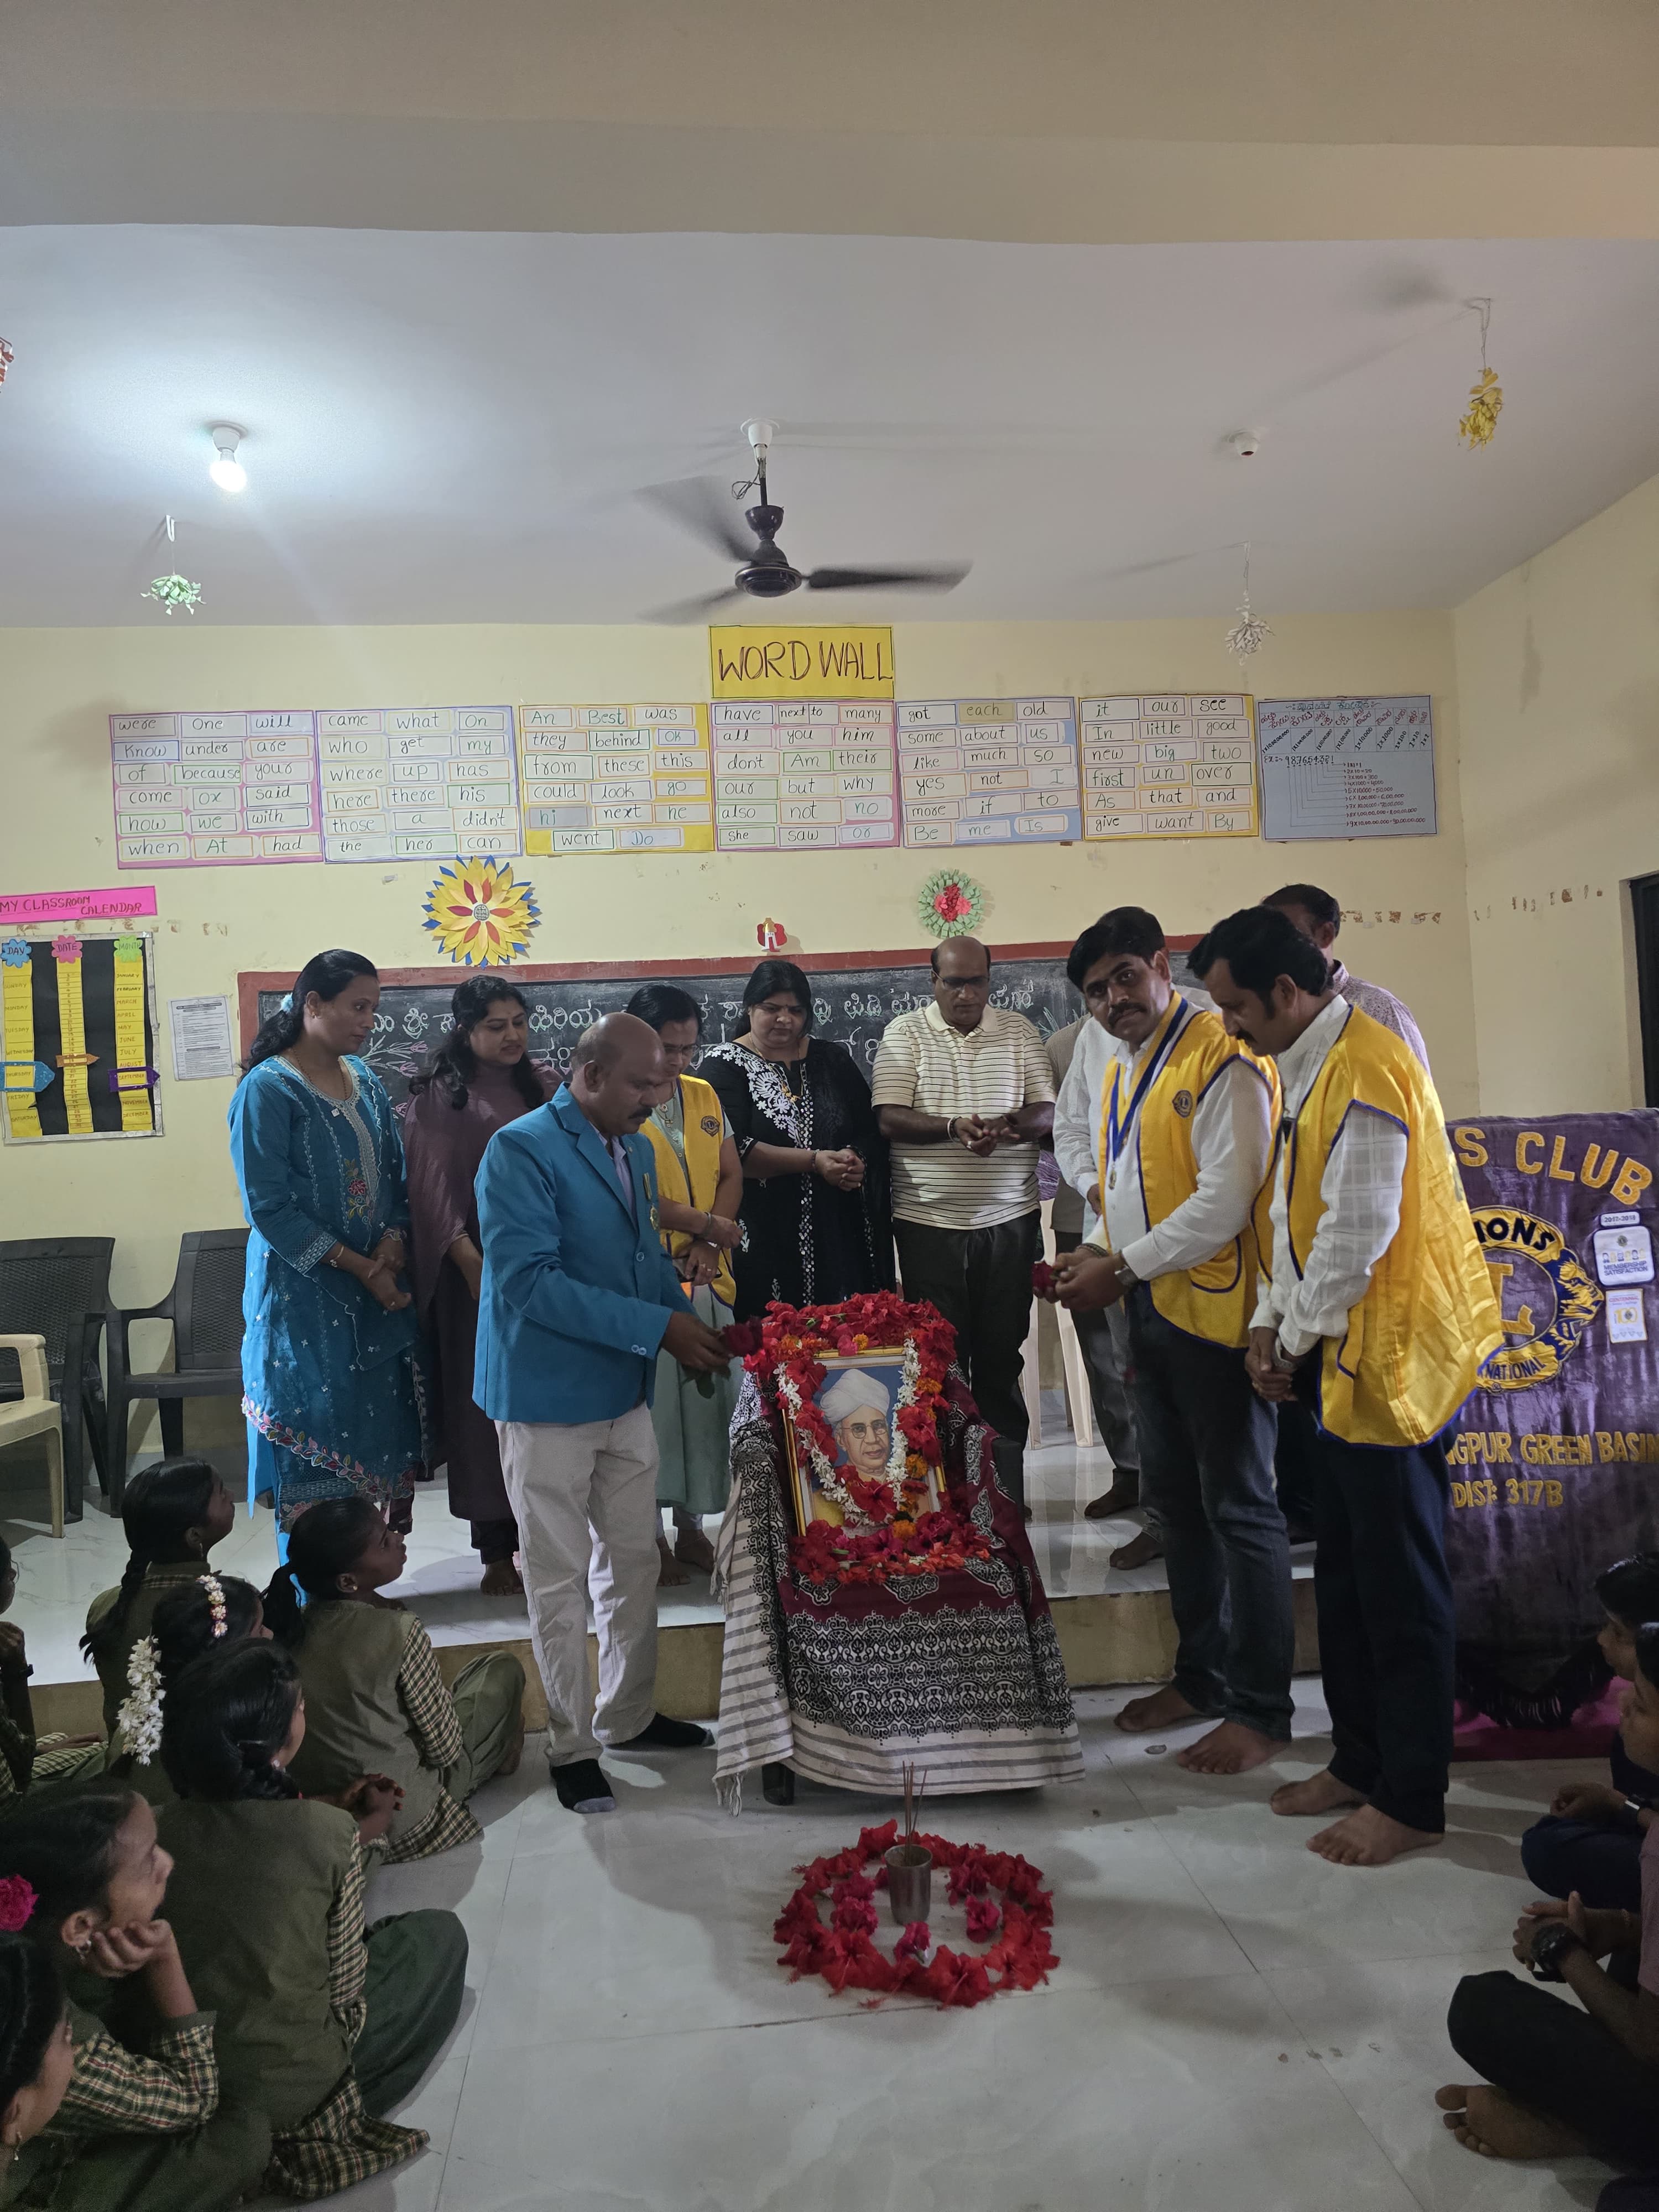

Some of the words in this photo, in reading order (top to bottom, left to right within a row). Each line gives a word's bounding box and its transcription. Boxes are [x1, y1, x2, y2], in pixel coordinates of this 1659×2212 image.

[718, 640, 811, 681] WORD
[819, 641, 893, 681] WALL
[780, 706, 806, 717] next
[811, 706, 822, 717] to
[967, 703, 1000, 716] each
[1023, 701, 1048, 716] old
[1097, 703, 1109, 717] it
[1152, 700, 1178, 712] our
[328, 714, 369, 726] came
[397, 712, 439, 729] what
[531, 711, 556, 725] An
[588, 708, 624, 724] Best
[645, 707, 677, 720] was
[724, 706, 761, 721] have
[845, 709, 880, 723] many
[909, 706, 931, 722] got
[118, 719, 156, 730] were
[192, 718, 222, 730] One
[255, 715, 293, 728] will
[1146, 723, 1181, 734] little
[1206, 719, 1238, 735] good
[595, 730, 642, 747] behind
[723, 729, 749, 741] all
[787, 730, 814, 744] you
[843, 727, 874, 742] him
[908, 731, 943, 744] some
[965, 726, 1005, 741] about
[1030, 727, 1048, 739] us
[1094, 727, 1114, 740] In
[185, 741, 228, 754] under
[257, 741, 286, 752] are
[328, 737, 367, 753] who
[400, 735, 424, 754] get
[468, 739, 492, 754] my
[533, 732, 566, 750] they
[838, 750, 877, 765] their
[971, 748, 1008, 761] much
[1093, 748, 1123, 760] new
[1155, 745, 1175, 761] big
[1212, 744, 1241, 759] two
[534, 755, 576, 775] from
[604, 759, 644, 772] these
[661, 753, 693, 768] this
[791, 754, 820, 767] Am
[914, 756, 940, 770] like
[128, 764, 146, 781] of
[182, 765, 241, 779] because
[255, 763, 292, 779] your
[331, 765, 383, 781] where
[403, 765, 428, 781] up
[457, 763, 488, 776] has
[1050, 769, 1063, 784] I
[1197, 766, 1233, 779] over
[844, 776, 873, 791] why
[981, 772, 1002, 785] not
[1093, 769, 1124, 786] first
[256, 785, 292, 800] said
[534, 784, 577, 798] could
[602, 782, 634, 799] look
[668, 781, 686, 795] go
[725, 781, 754, 794] our
[788, 778, 815, 793] but
[916, 778, 945, 796] yes
[392, 789, 435, 802] there
[460, 786, 486, 802] his
[1038, 792, 1058, 806] to
[1095, 794, 1115, 808] As
[1150, 788, 1182, 803] that
[1206, 788, 1237, 802] and
[333, 795, 372, 808] here
[855, 802, 878, 815] no
[979, 796, 995, 815] if
[252, 809, 284, 823] with
[604, 804, 642, 818] next
[668, 806, 687, 820] he
[722, 805, 755, 818] also
[790, 800, 817, 819] not
[912, 805, 946, 816] more
[129, 817, 166, 831] how
[198, 816, 222, 828] we
[412, 813, 425, 824] a
[540, 809, 556, 825] hi
[1096, 815, 1119, 831] give
[1155, 812, 1194, 828] want
[1215, 813, 1233, 831] By
[332, 819, 374, 832] those
[969, 824, 991, 835] me
[1024, 820, 1043, 831] Is
[561, 833, 599, 845] went
[632, 831, 653, 845] Do
[853, 830, 871, 838] or
[914, 826, 938, 841] Be
[128, 839, 179, 854] when
[206, 837, 228, 853] At
[273, 836, 302, 851] had
[341, 842, 362, 852] the
[405, 838, 432, 851] her
[467, 836, 501, 849] can
[0, 899, 18, 912] MY
[23, 895, 90, 911] CLASSROOM
[81, 902, 142, 915] CALENDAR
[57, 942, 77, 952] DATE
[1516, 1131, 1652, 1205] CLUB
[1474, 1217, 1555, 1250] IONS
[1604, 1261, 1646, 1270] MEMBERSHIP
[1605, 1266, 1648, 1276] SATISFACTION
[1484, 1356, 1546, 1380] NATIONAL
[1521, 1433, 1593, 1464] GREEN
[1451, 1479, 1498, 1508] DIST:
[1506, 1478, 1563, 1507] 317B
